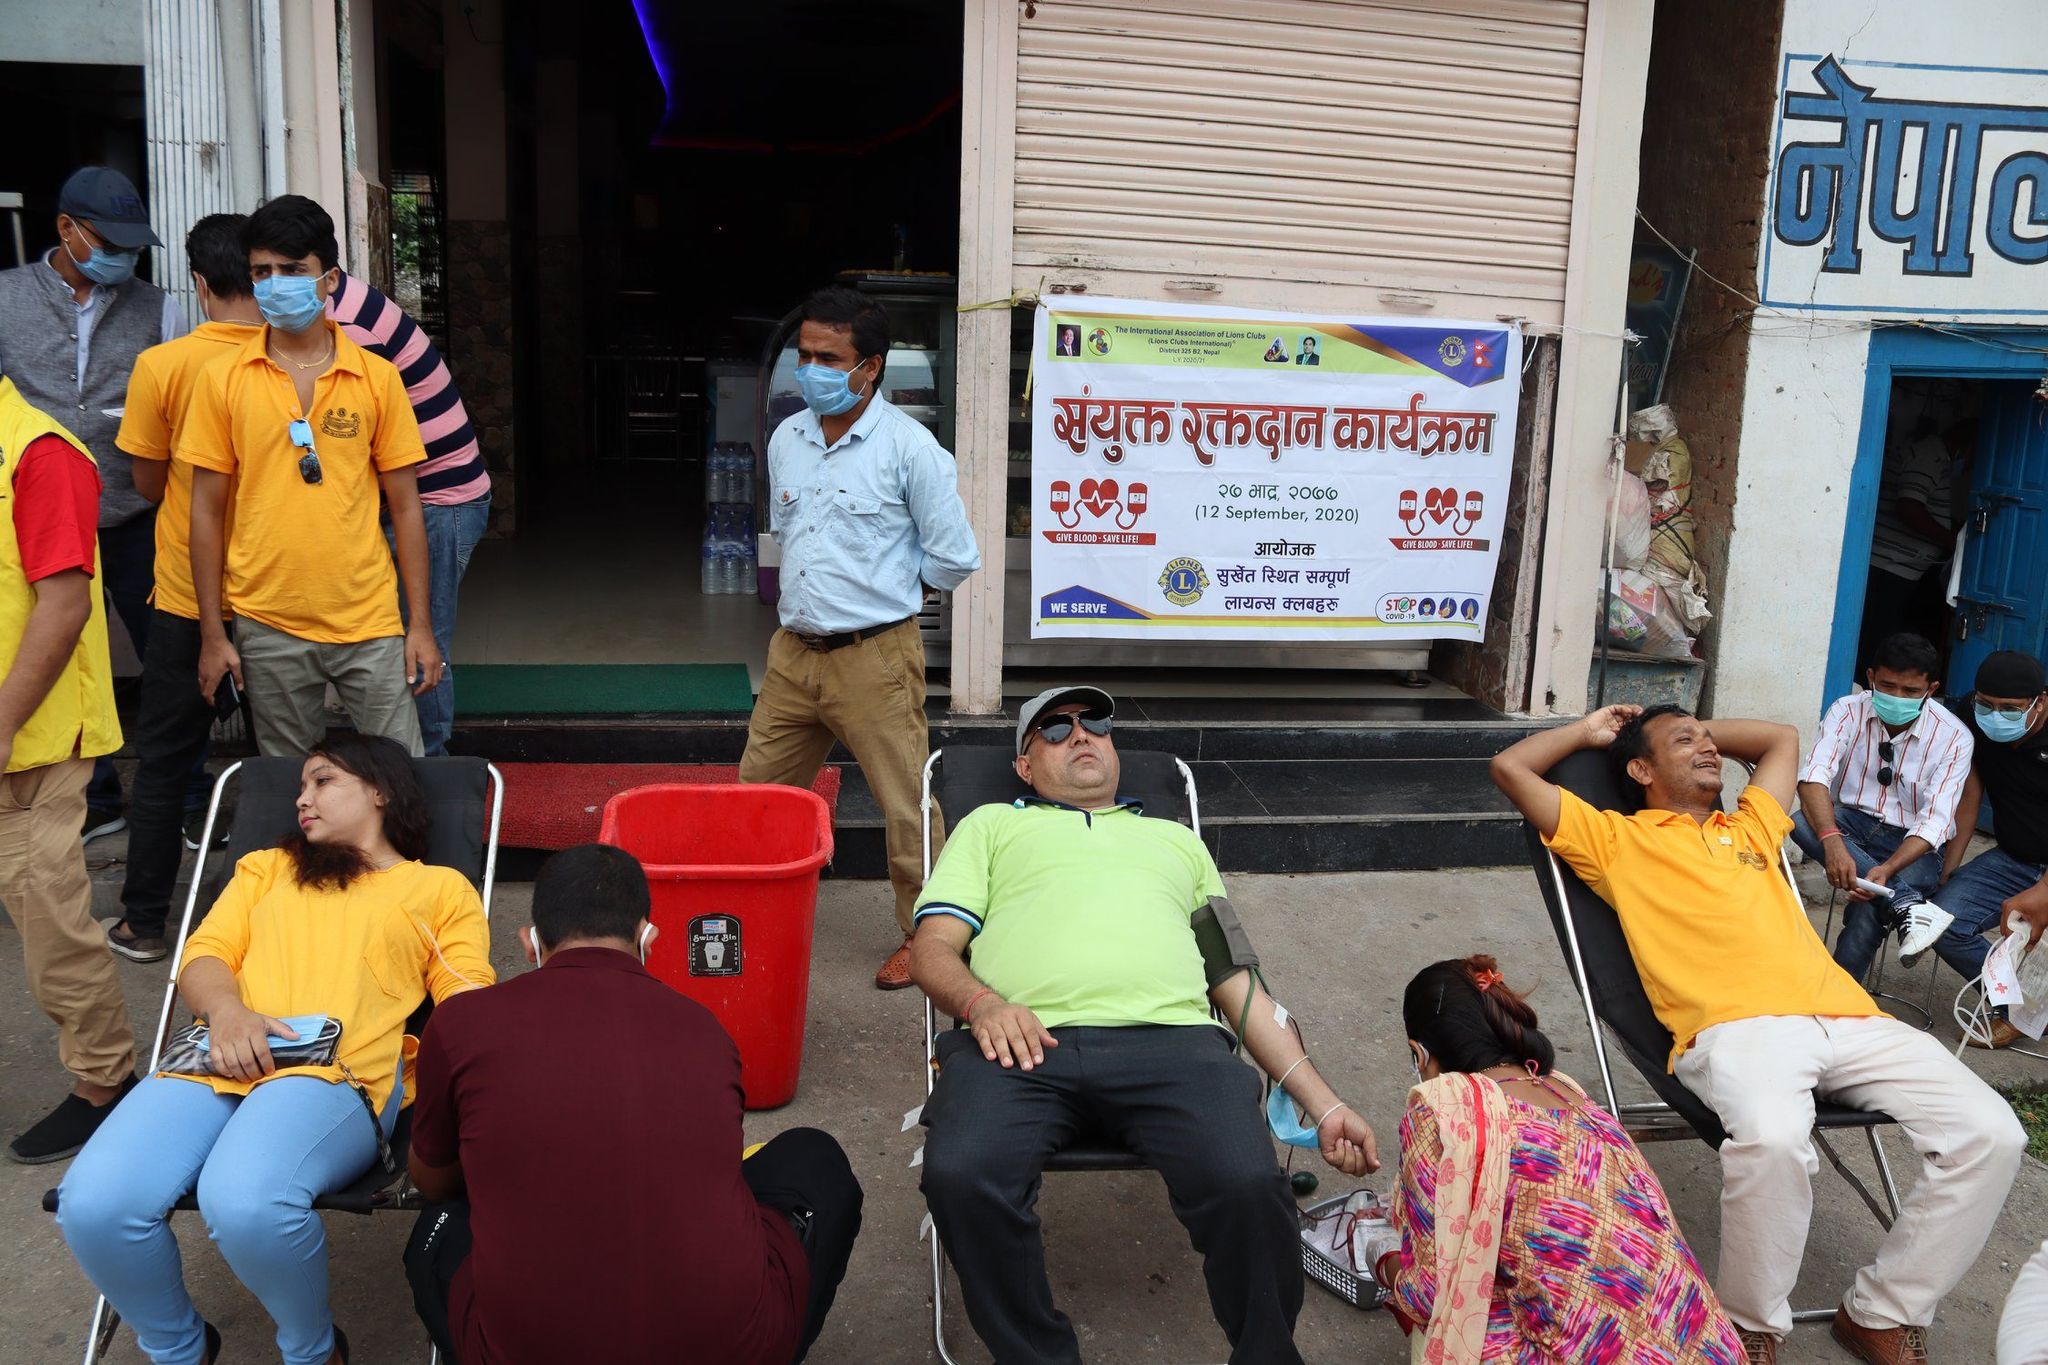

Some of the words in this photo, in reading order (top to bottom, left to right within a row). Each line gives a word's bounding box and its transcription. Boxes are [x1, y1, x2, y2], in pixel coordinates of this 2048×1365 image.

[1115, 326, 1128, 334] The
[1129, 327, 1173, 336] International
[1174, 329, 1216, 338] Association
[1216, 330, 1225, 338] of
[1225, 331, 1246, 339] Lions
[1246, 332, 1266, 340] Clubs
[1148, 338, 1168, 346] (Lions
[1169, 338, 1189, 346] Clubs
[1051, 383, 1176, 465] संयुक्त
[1180, 400, 1328, 466] रक्तदान
[1332, 392, 1498, 459] कार्यक्रम
[1218, 484, 1242, 498] २७
[1248, 484, 1280, 502] भाद्र,
[1288, 486, 1338, 501] २०७७
[1195, 505, 1219, 521] (12
[1226, 505, 1309, 523] September,
[1315, 508, 1359, 525] 2020)
[1055, 533, 1072, 542] GIVE
[1073, 533, 1097, 543] BLOOD
[1102, 534, 1120, 543] SAVE
[1121, 534, 1139, 544] LIFE!
[1402, 540, 1416, 549] GIVE
[1417, 540, 1438, 549] BLOOD
[1441, 540, 1456, 549] SAVE
[1457, 540, 1473, 549] LIFE!
[1254, 538, 1316, 557] आयोजक
[1169, 559, 1200, 571] LIONS
[1178, 572, 1192, 590] L
[1216, 564, 1256, 587] सुर्खेत
[1262, 565, 1300, 584] स्थित
[1305, 568, 1351, 589] सम्पूर्ण
[1050, 603, 1067, 614] WE
[1070, 603, 1108, 614] SERVE
[1224, 596, 1277, 611] लायन्स
[1385, 597, 1417, 613] STOP
[692, 934, 719, 943] Swing
[720, 933, 737, 943] Bin
